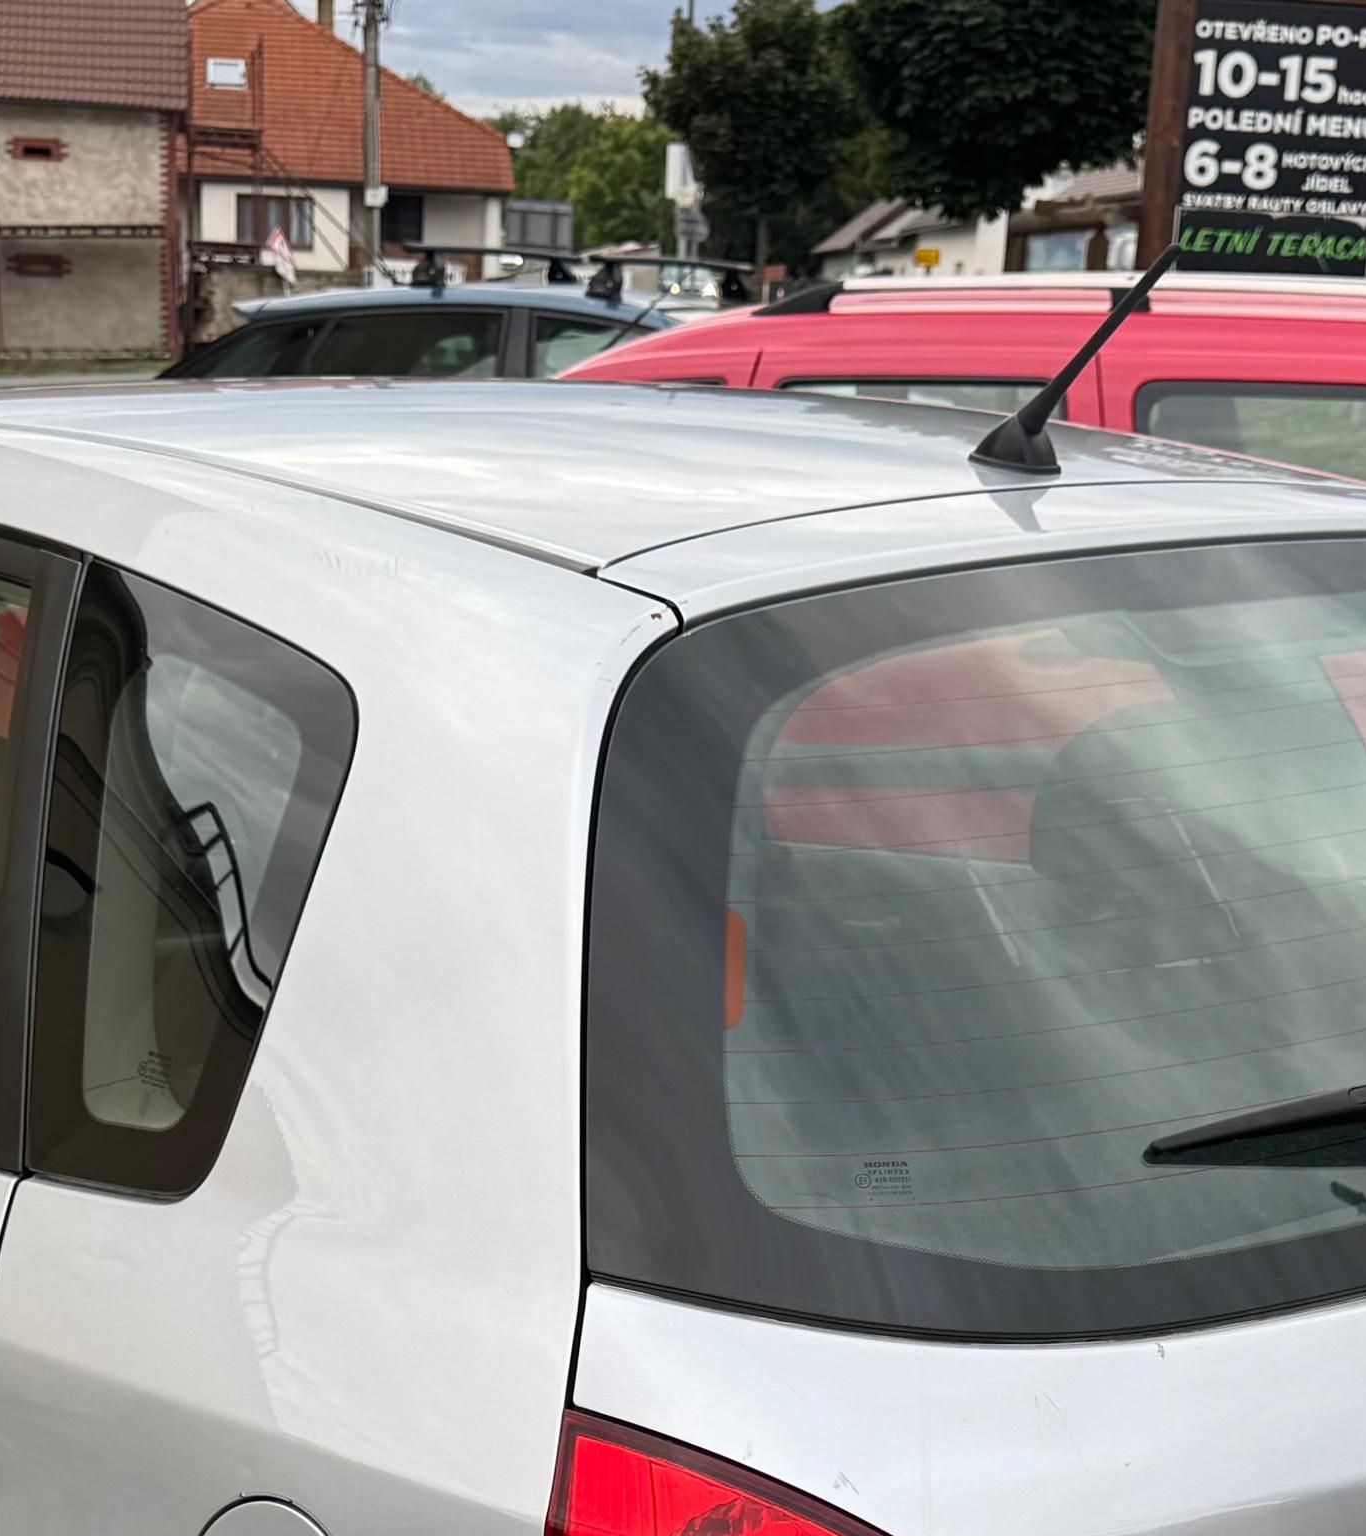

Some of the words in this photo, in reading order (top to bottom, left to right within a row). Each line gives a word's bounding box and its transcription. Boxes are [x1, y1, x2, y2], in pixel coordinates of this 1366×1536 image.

[1195, 18, 1314, 45] OTEVŘENO
[1193, 49, 1338, 104] 10-15
[1187, 107, 1304, 136] POLEDNÍ
[1184, 138, 1279, 191] 6-8
[1301, 172, 1354, 194] JÍDEL
[1182, 191, 1246, 210] SVATBY
[1247, 194, 1306, 212] RAUTY
[1179, 225, 1264, 255] LETNÍ
[864, 1161, 908, 1169] HONDA
